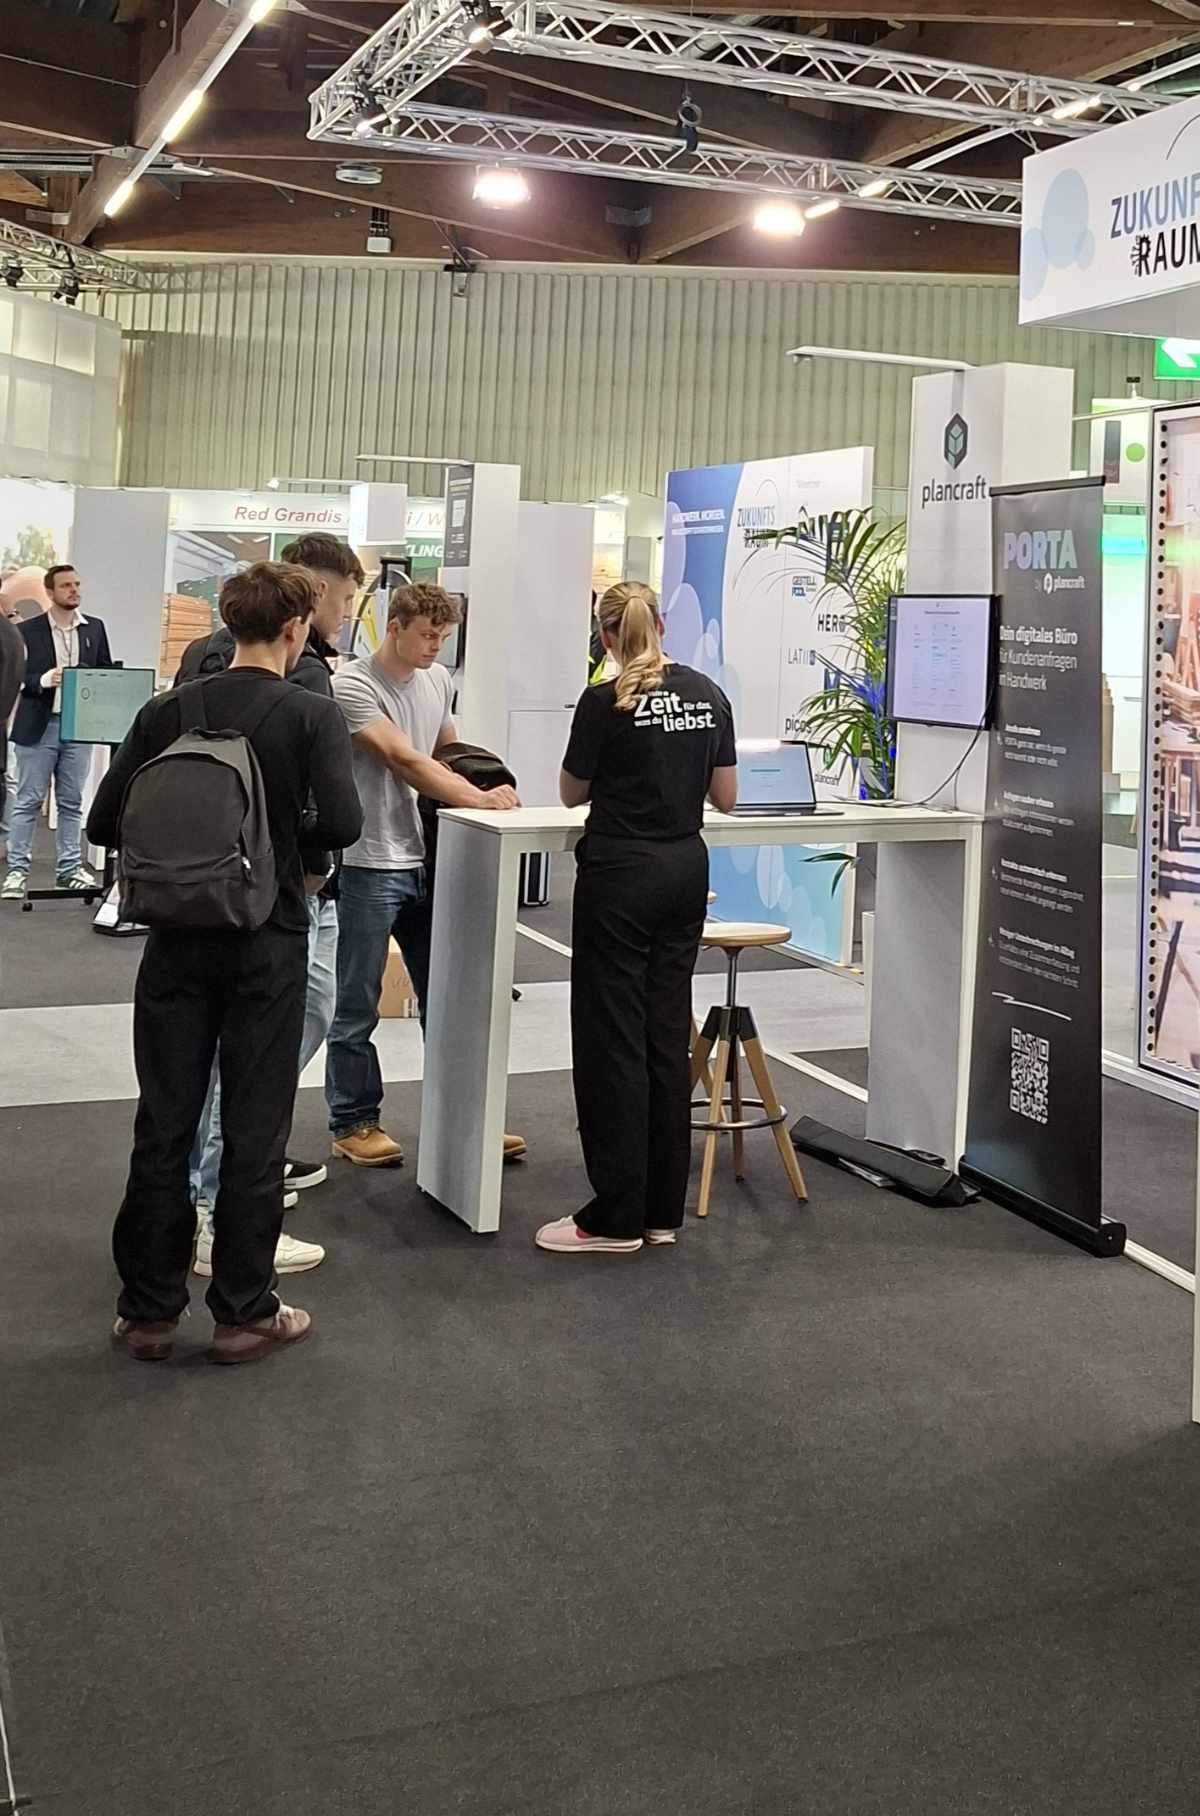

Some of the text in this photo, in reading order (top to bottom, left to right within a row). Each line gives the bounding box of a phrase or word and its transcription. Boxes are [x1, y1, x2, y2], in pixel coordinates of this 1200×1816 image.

[921, 474, 987, 510] plancraft
[234, 505, 272, 522] Red
[274, 506, 343, 524] Grandis
[1003, 529, 1078, 570] PORTA
[1016, 625, 1053, 646] digitales
[1055, 627, 1078, 645] Büro
[634, 691, 683, 718] Zeit
